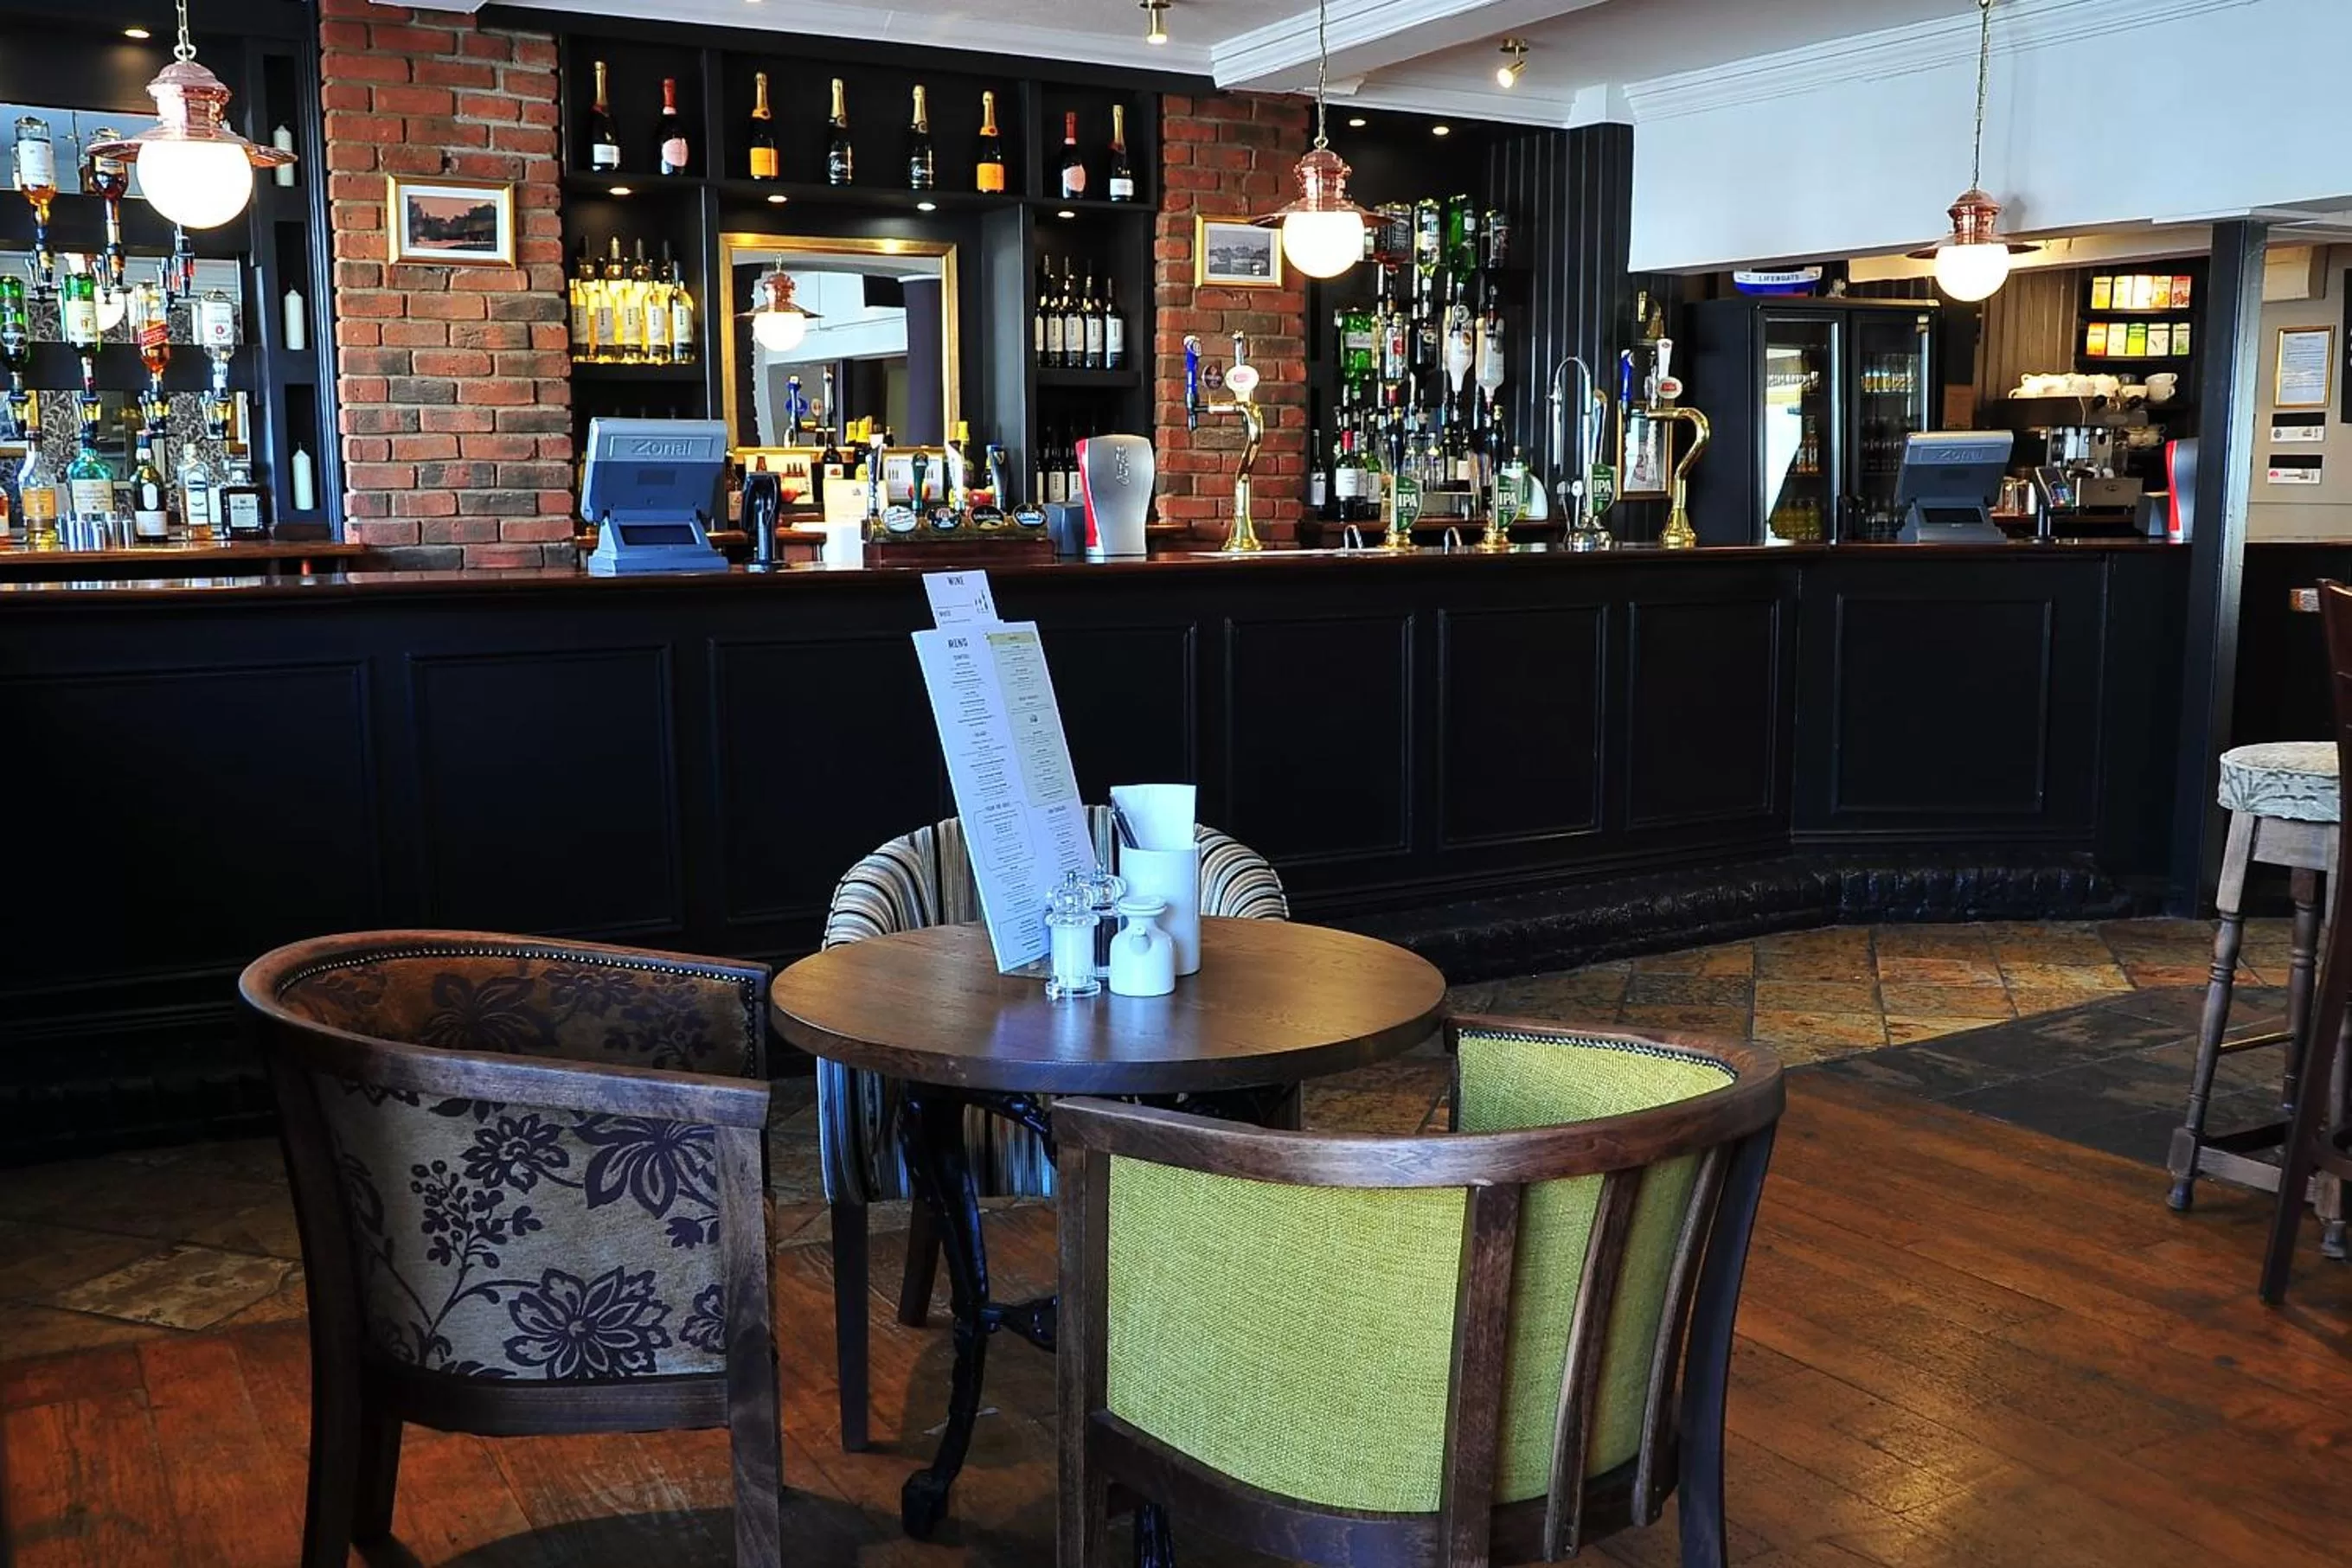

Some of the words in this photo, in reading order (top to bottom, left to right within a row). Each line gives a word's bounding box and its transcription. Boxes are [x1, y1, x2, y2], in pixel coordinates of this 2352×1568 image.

[632, 438, 692, 456] Zonal
[1594, 479, 1612, 493] IPA
[1398, 494, 1418, 507] IPA
[1498, 492, 1517, 505] IPA
